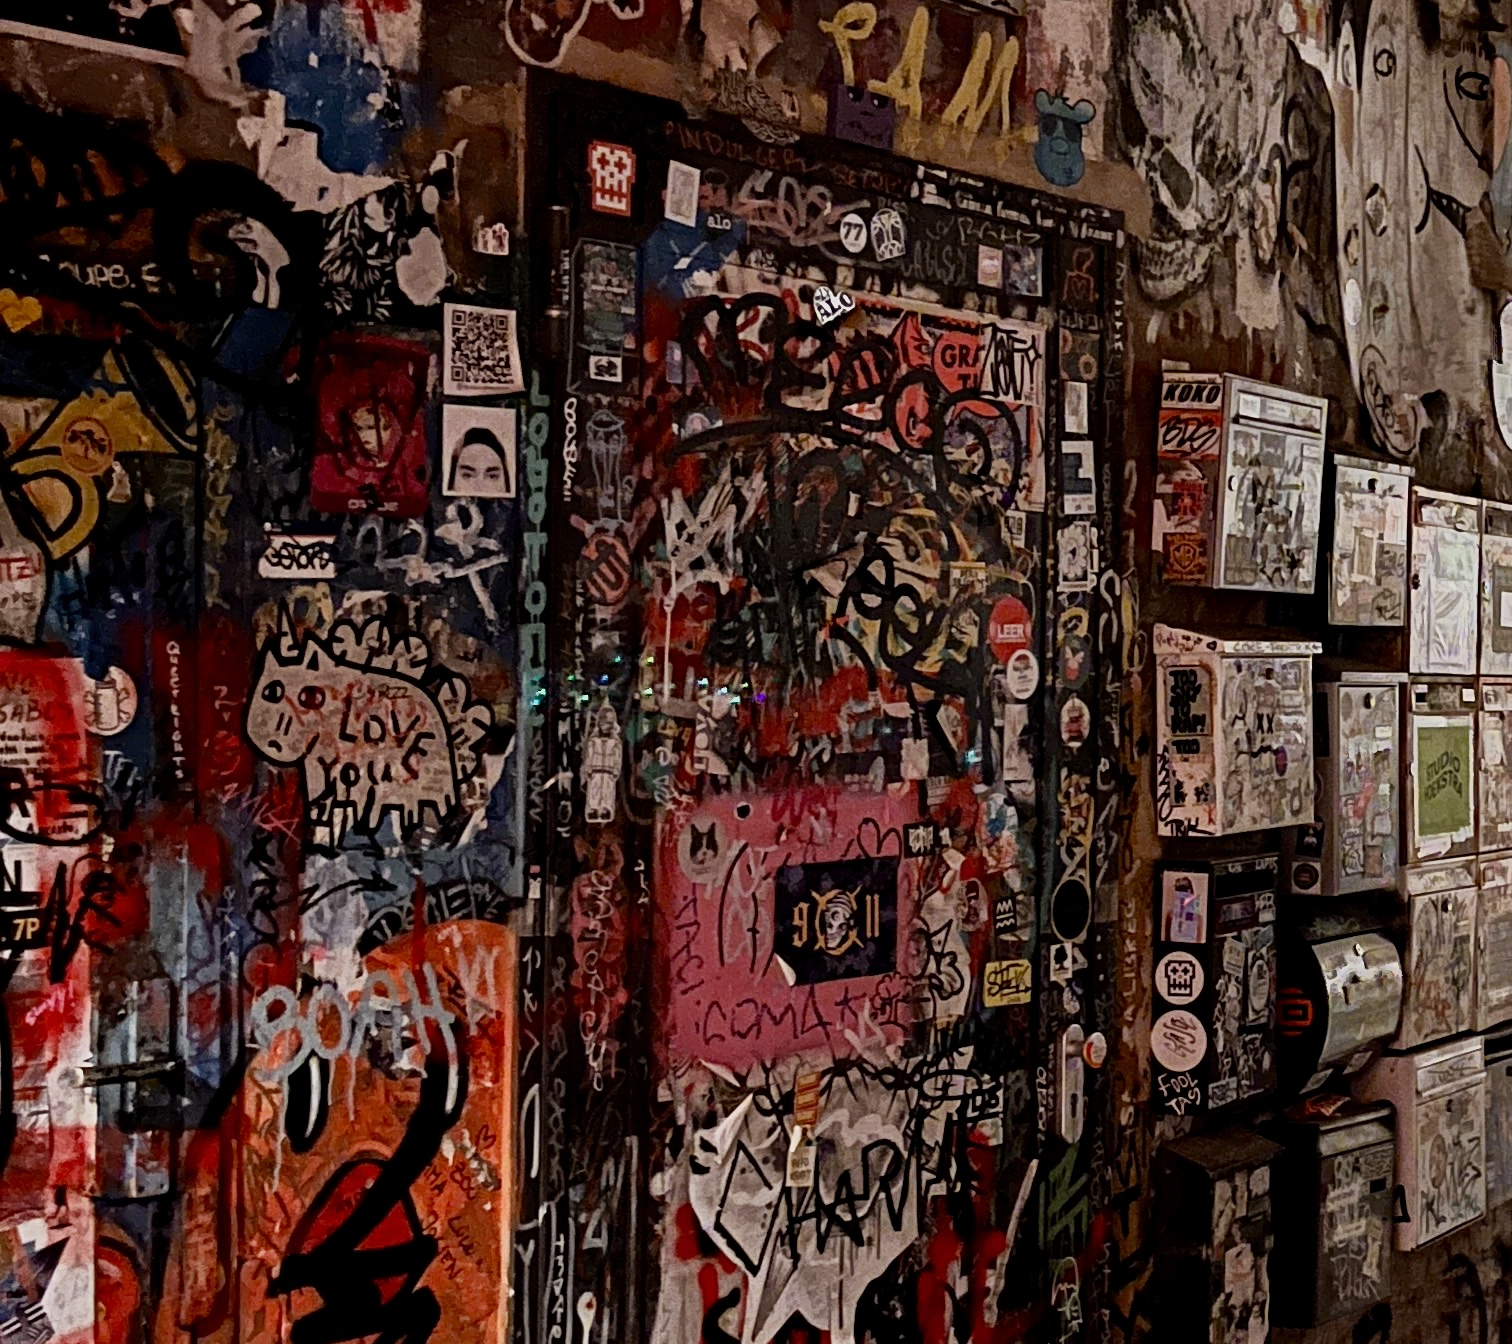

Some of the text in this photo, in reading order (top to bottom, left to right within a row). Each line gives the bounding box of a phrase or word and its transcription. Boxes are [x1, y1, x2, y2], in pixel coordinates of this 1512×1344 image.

[842, 221, 863, 242] 77
[1163, 383, 1221, 404] KOKO
[998, 623, 1025, 640] LEER
[1426, 750, 1461, 781] STUDIO
